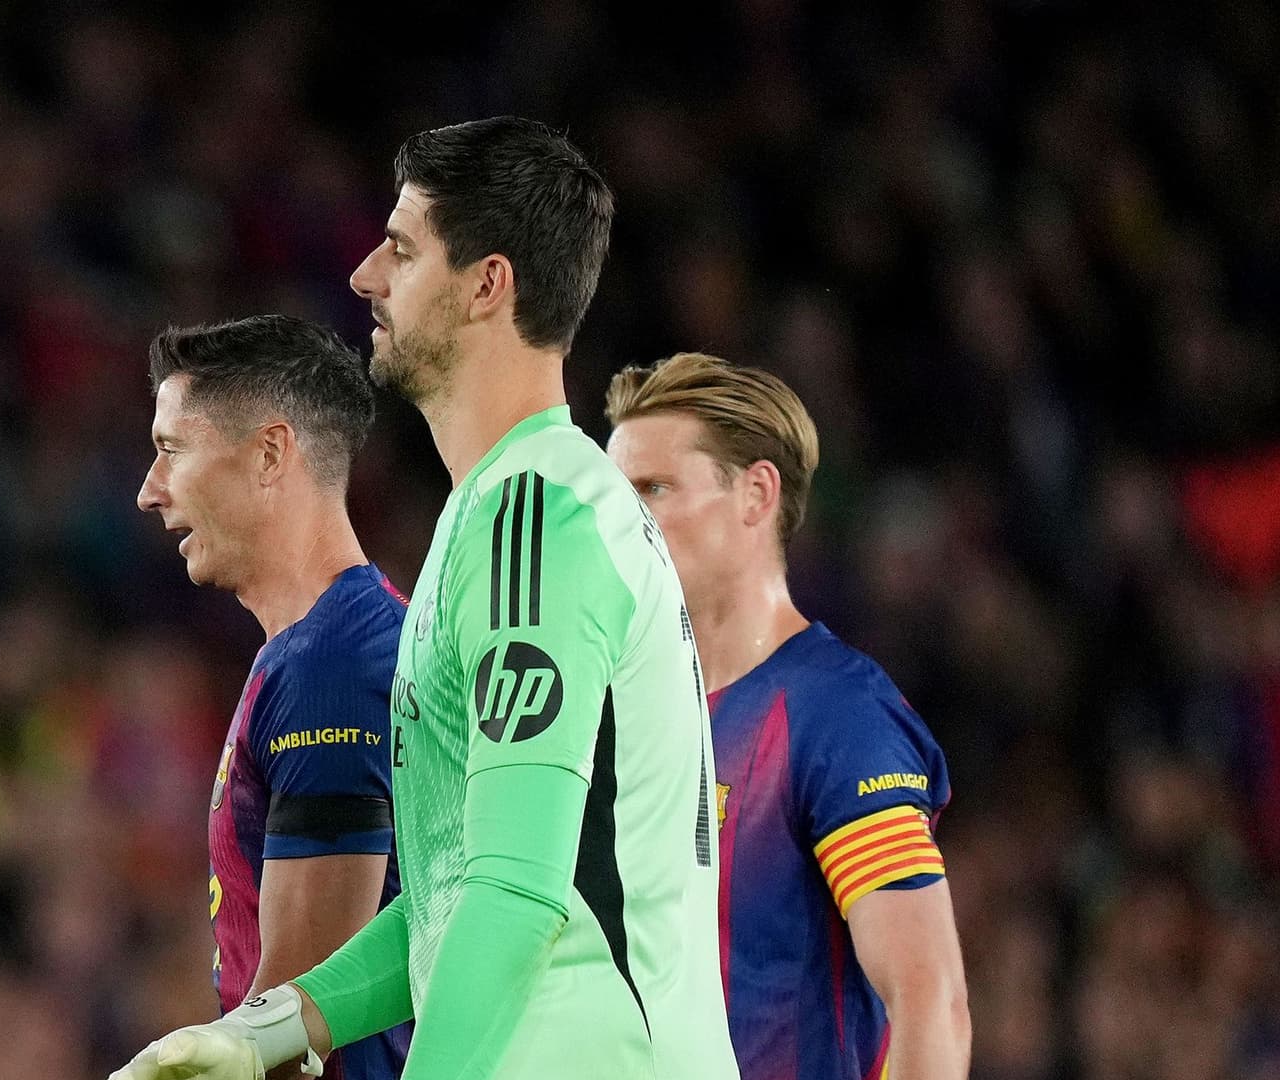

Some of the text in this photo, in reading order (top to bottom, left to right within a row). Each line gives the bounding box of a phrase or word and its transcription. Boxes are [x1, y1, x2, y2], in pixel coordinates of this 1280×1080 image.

[478, 641, 558, 743] hp
[269, 727, 382, 755] AMBILIGHT tv
[857, 772, 929, 797] AMBILIGHT
